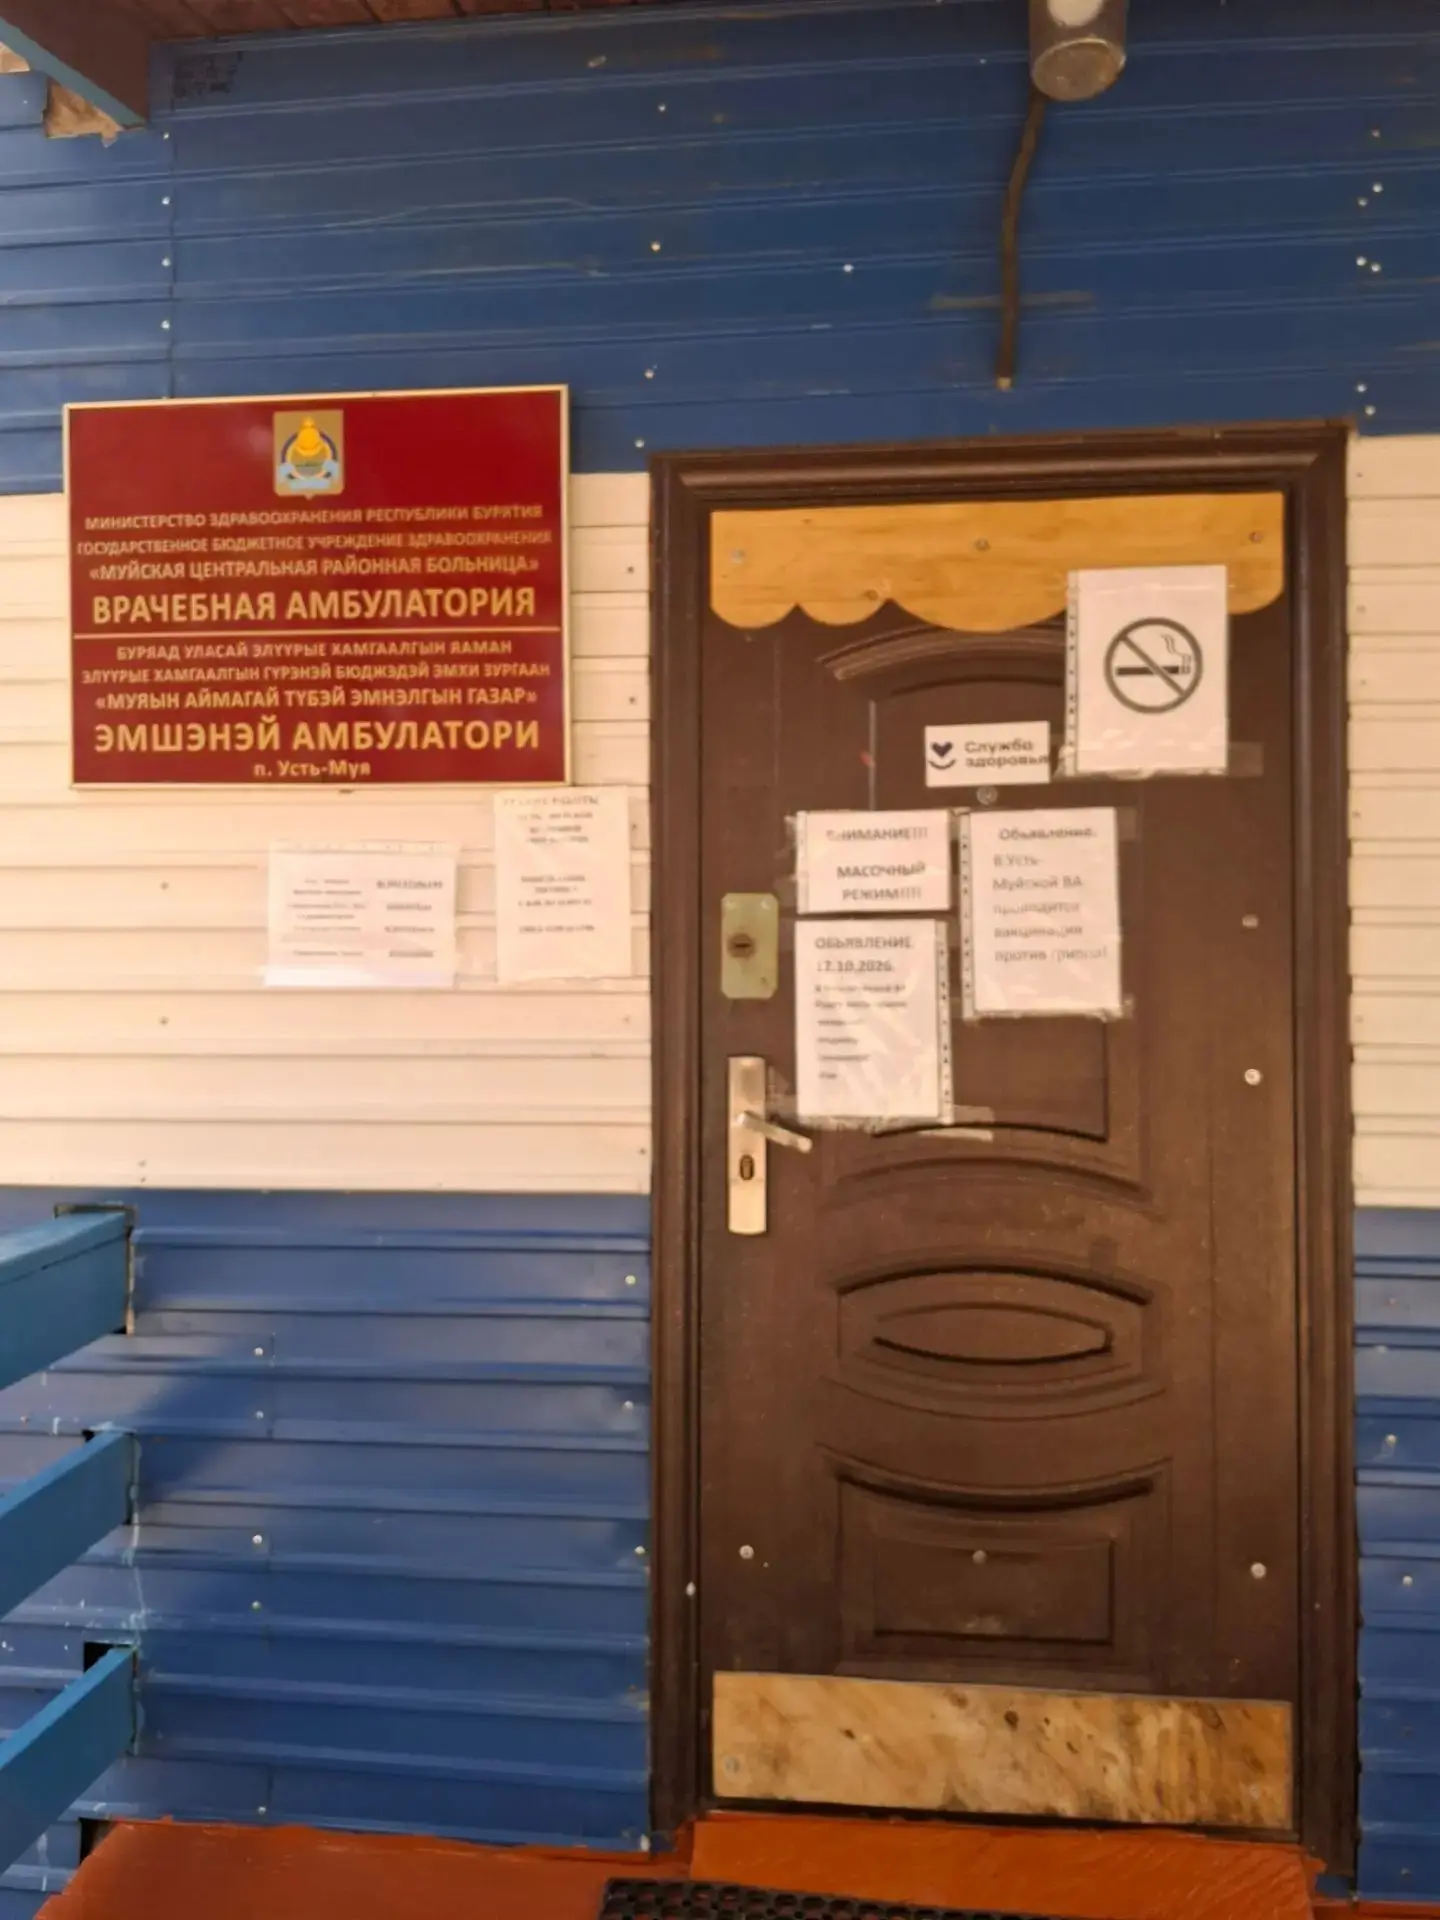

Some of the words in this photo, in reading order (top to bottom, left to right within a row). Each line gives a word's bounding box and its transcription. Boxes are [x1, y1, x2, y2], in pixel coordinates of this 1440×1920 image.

[85, 512, 206, 530] МИНИСТЕРСТВО
[209, 508, 362, 527] ЗДРАВООХРАНЕНИЯ
[366, 505, 469, 522] РЕСПУБЛИКИ
[472, 504, 543, 520] БУРЯТИЯ
[77, 537, 208, 556] ГОСУДАРСТВЕННОЕ
[212, 535, 304, 552] БЮДЖЕТНОЕ
[308, 533, 403, 551] УЧРЕЖДЕНИЕ
[409, 530, 552, 549] ЗДРАВООХРАНЕНИЯ
[89, 559, 185, 580] «МУЙСКАЯ
[189, 559, 318, 581] ЦЕНТРАЛЬНАЯ
[322, 554, 421, 575] РАЙОННАЯ
[426, 555, 539, 575] БОЛЬНИЦА»
[93, 592, 276, 624] ВРАЧЕБНАЯ
[286, 586, 535, 620] АМБУЛАТОРИЯ
[116, 645, 180, 661] БУРЯАД
[184, 641, 248, 659] УЛАСАЙ
[331, 641, 445, 656] ХАМГААЛГЫН
[451, 640, 512, 655] ЯАМАН
[154, 666, 259, 683] ХАМГААЛГЫН
[336, 662, 429, 682] БЮДЖЭДЭЙ
[433, 663, 479, 679] ЭМХИ
[95, 692, 179, 710] «МУЯЫН
[185, 686, 279, 709] АЙМАГАЙ
[351, 688, 462, 706] ЭМНЭЛГЫН
[467, 687, 537, 705] ГАЗАР»
[94, 714, 280, 752] ЭМШЭНЭЙ
[292, 720, 539, 750] АМБУЛАТОРИ
[965, 738, 1033, 754] Служба
[254, 762, 272, 777] п.
[278, 759, 371, 778] Усть-Муя
[966, 755, 1049, 768] здоровья
[837, 861, 926, 880] МАСОЧНЫЙ
